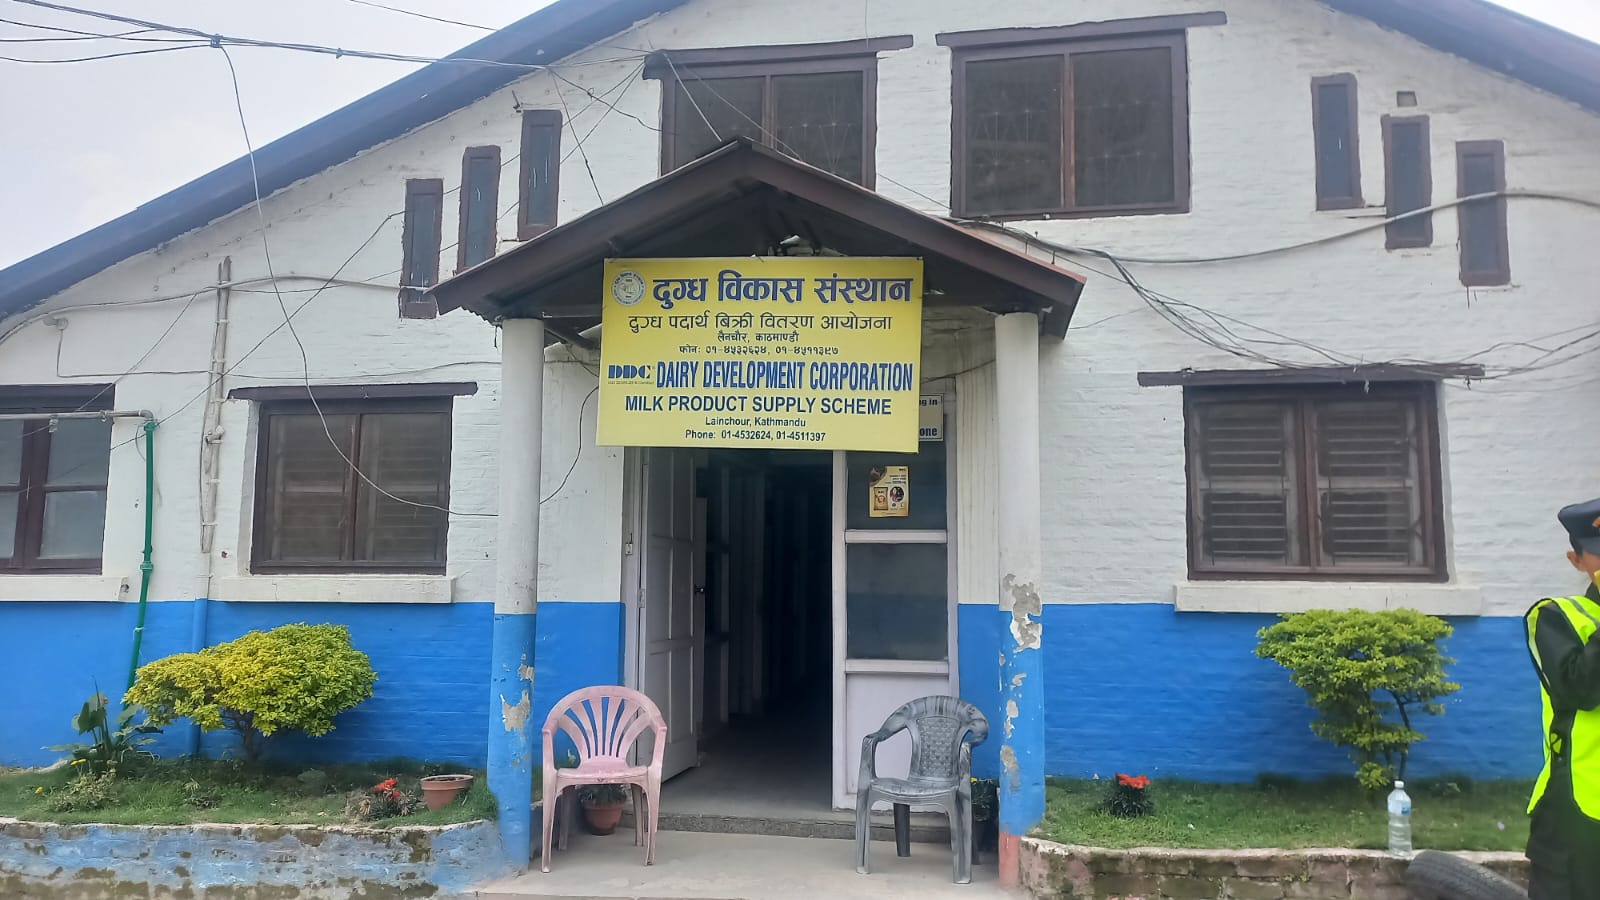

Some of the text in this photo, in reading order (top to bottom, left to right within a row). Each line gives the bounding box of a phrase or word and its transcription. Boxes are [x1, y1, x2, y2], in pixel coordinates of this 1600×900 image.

[653, 278, 709, 310] दुग्ध
[718, 269, 805, 303] विकास
[814, 273, 914, 303] संस्थान
[628, 310, 893, 333] दुग्ध पदार्थ बिक्री वितरण आयोजना
[608, 365, 651, 379] DDC
[656, 361, 914, 391] DAIRY DEVELOPMENT CORPORATION
[625, 396, 892, 415] MILK PRODUCT SUPPLY SCHEME
[705, 416, 806, 427] Lainchour, Kathmandu
[685, 429, 826, 442] Phone: 01-4532624, 01-4511397
